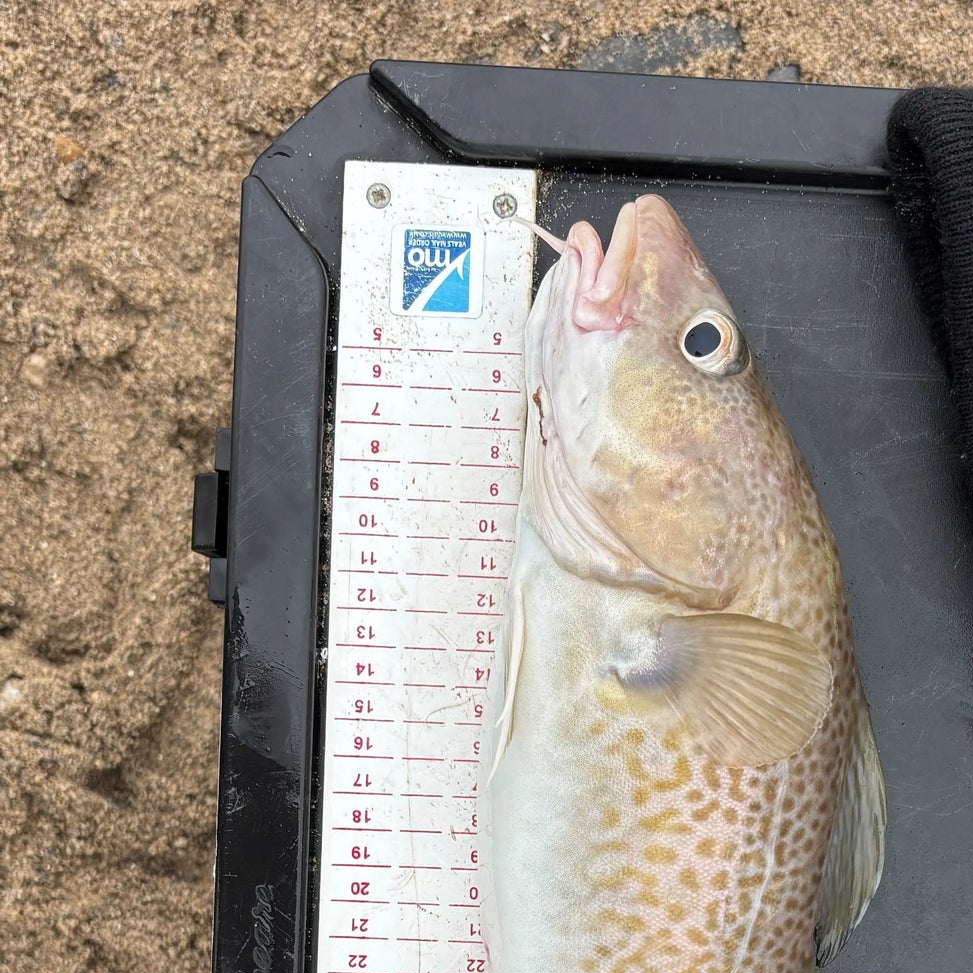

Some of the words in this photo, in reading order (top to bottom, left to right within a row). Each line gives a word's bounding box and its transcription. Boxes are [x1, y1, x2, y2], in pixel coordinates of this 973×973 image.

[373, 327, 382, 341] 5
[493, 332, 502, 346] 5
[372, 364, 382, 379] 6
[492, 369, 502, 384] 6
[371, 403, 380, 416] 7
[490, 408, 499, 422] 7
[370, 439, 380, 454] 8
[490, 444, 500, 460] 8
[369, 477, 379, 491] 9
[488, 482, 500, 497] 9
[358, 514, 377, 528] 10
[478, 519, 496, 533] 10
[360, 551, 376, 565] 11
[481, 557, 496, 571] 11
[357, 588, 375, 602] 12
[476, 592, 495, 608] 12
[356, 625, 374, 639] 13
[475, 630, 494, 645] 13
[355, 662, 374, 676] 14
[354, 699, 372, 713] 15
[354, 736, 372, 751] 16
[353, 774, 371, 787] 17
[352, 809, 371, 824] 18
[350, 845, 370, 860] 19
[350, 881, 370, 896] 20
[351, 918, 368, 933] 21
[348, 954, 367, 969] 22
[466, 957, 486, 973] 22
